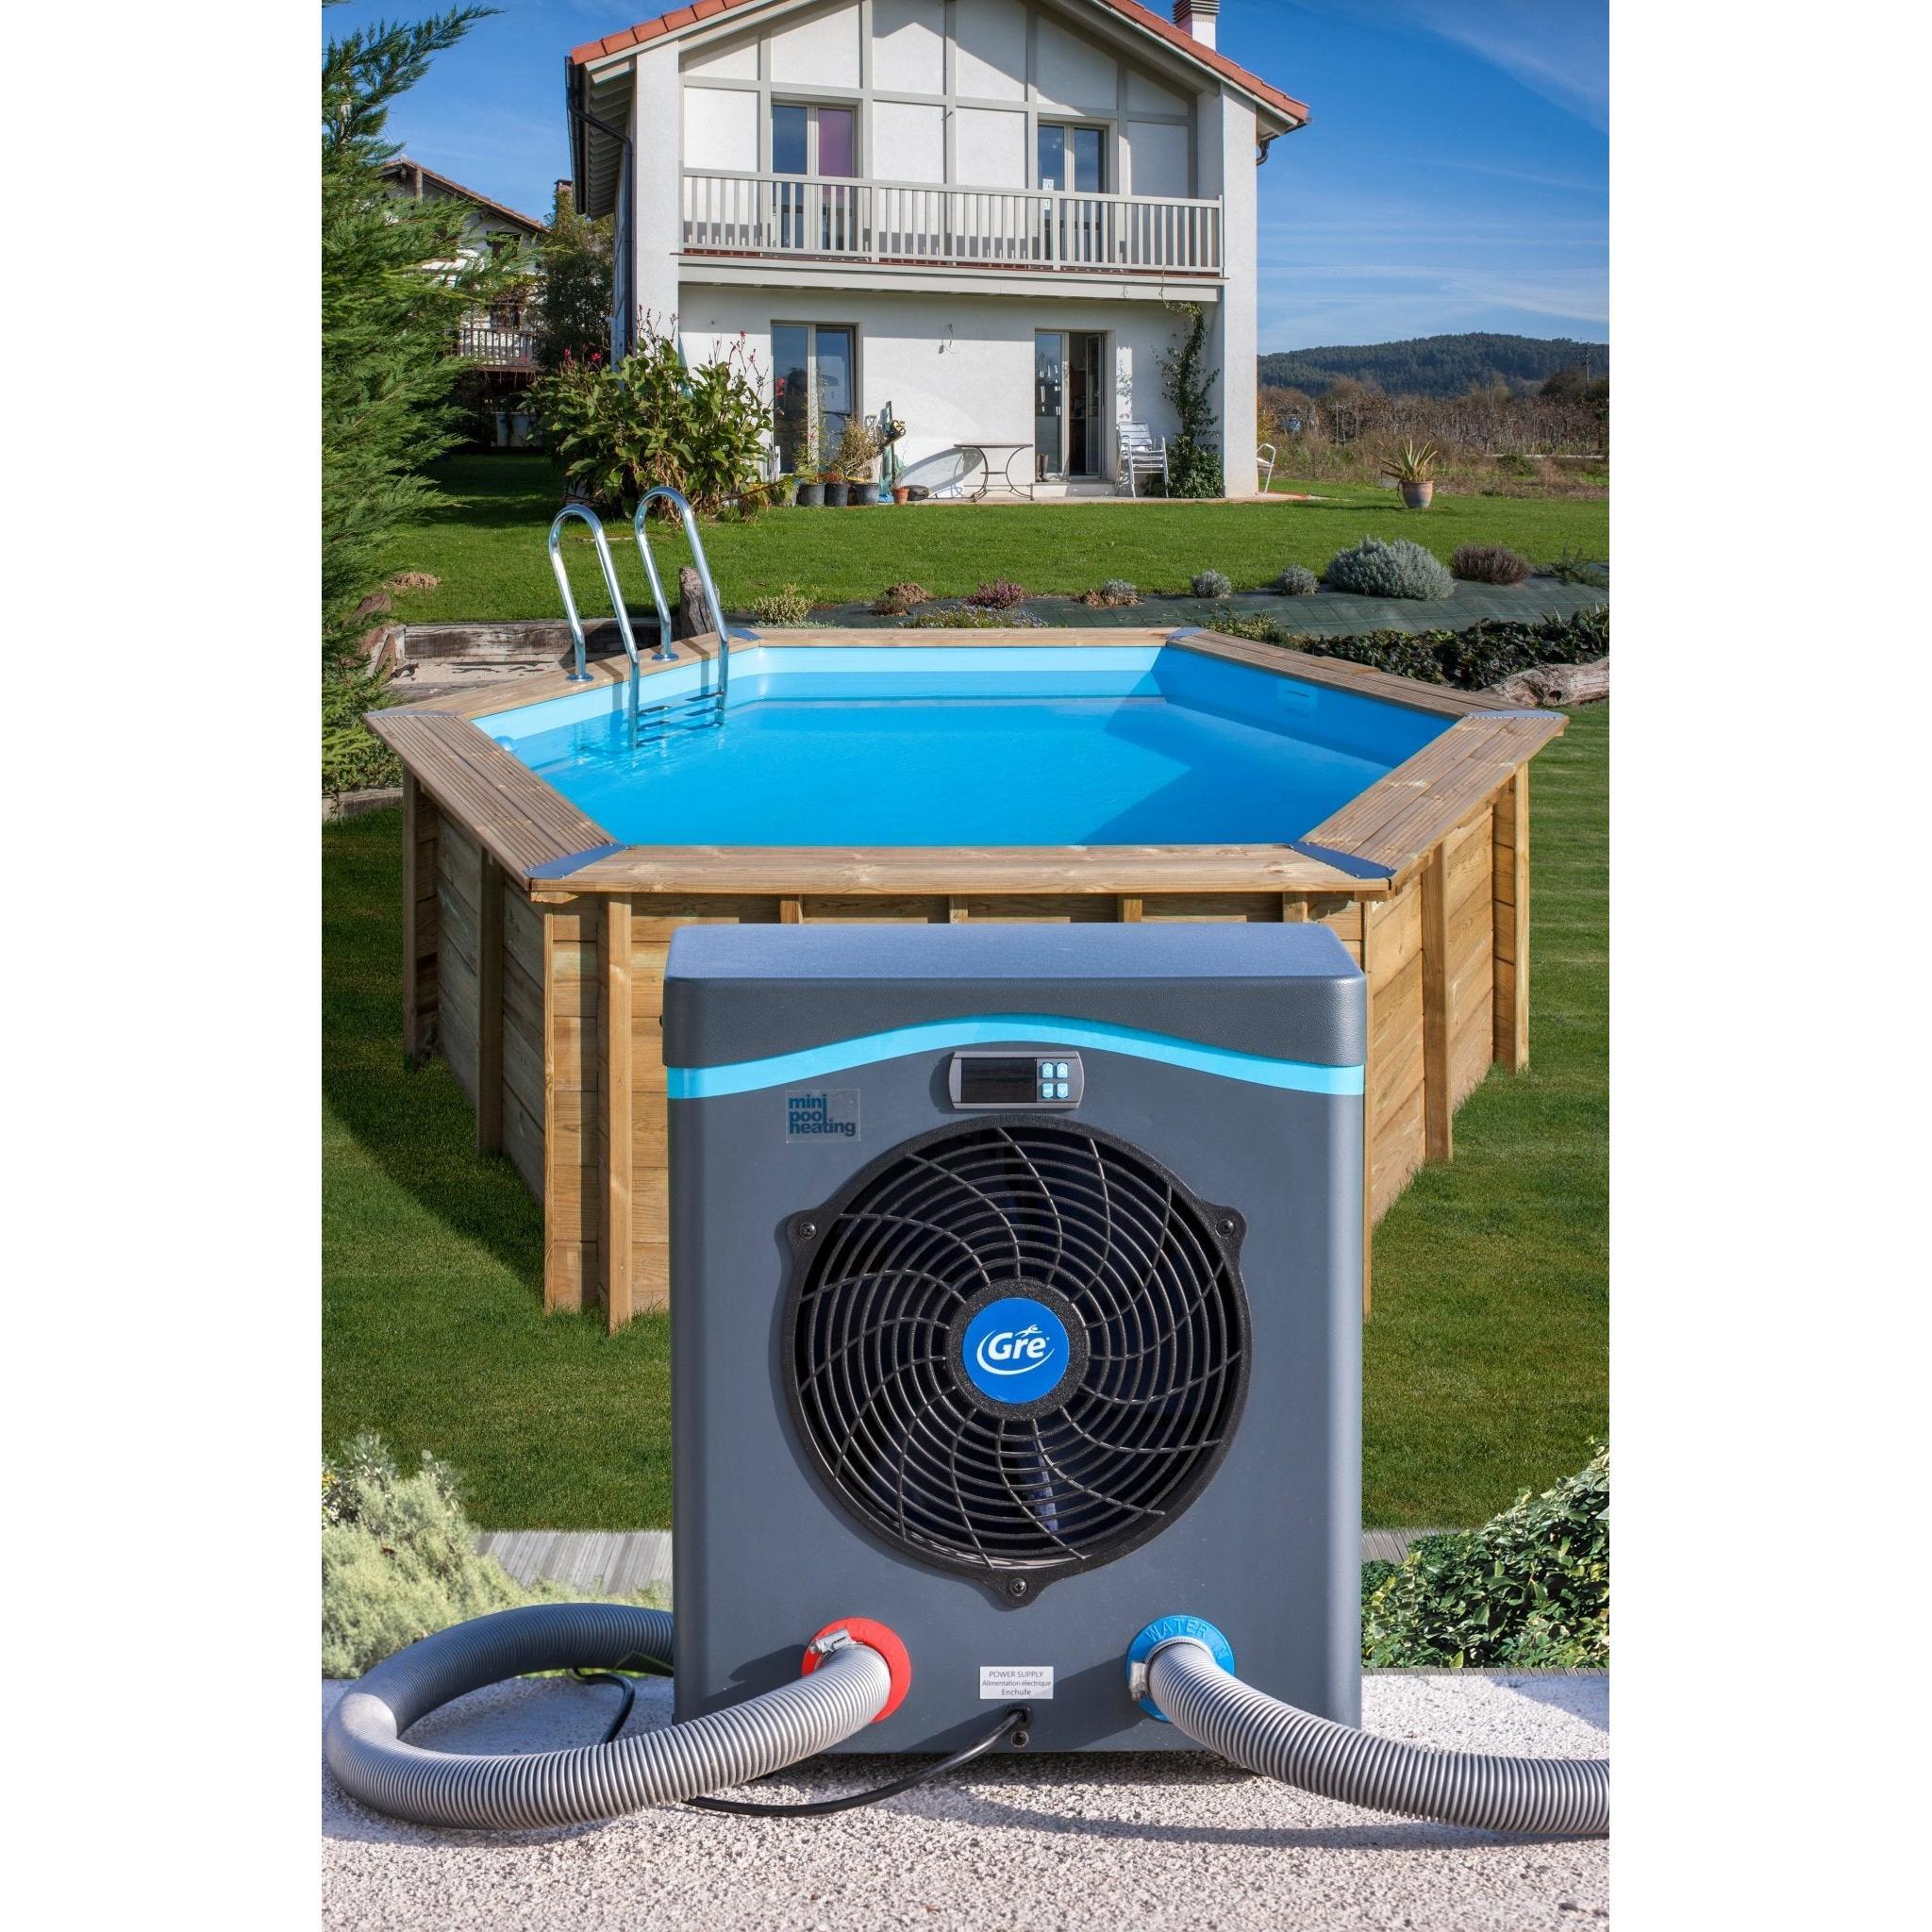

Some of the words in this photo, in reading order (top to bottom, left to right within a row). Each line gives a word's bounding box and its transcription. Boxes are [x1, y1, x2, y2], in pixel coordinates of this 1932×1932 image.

[789, 1093, 827, 1108] mini
[789, 1107, 827, 1124] pool
[789, 1117, 856, 1137] heating
[988, 1331, 1046, 1360] Gre
[1145, 1618, 1208, 1642] WATER
